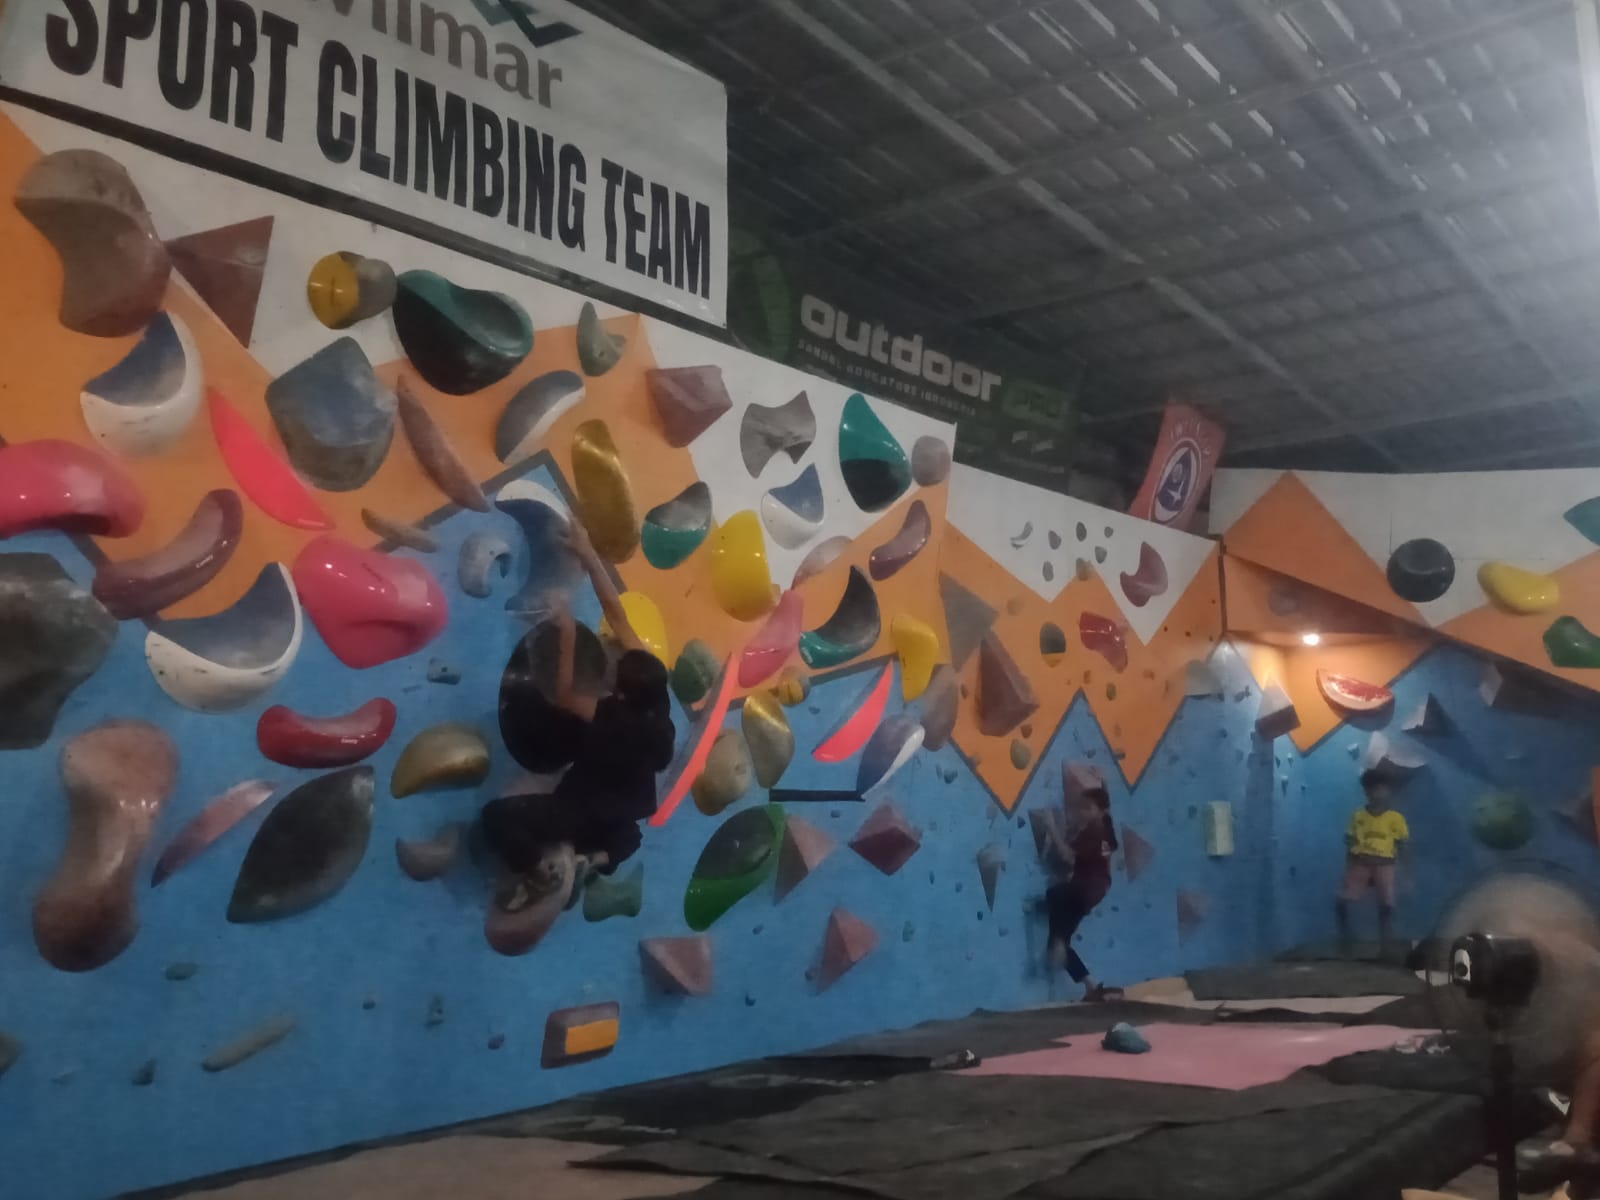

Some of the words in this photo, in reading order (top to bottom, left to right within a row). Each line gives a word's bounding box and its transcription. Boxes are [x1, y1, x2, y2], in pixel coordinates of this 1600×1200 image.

[309, 0, 563, 108] ilmar
[45, 0, 299, 143] SPORT
[316, 39, 587, 251] CLIMBING
[599, 158, 710, 299] TEAM
[800, 293, 1002, 402] outdoor
